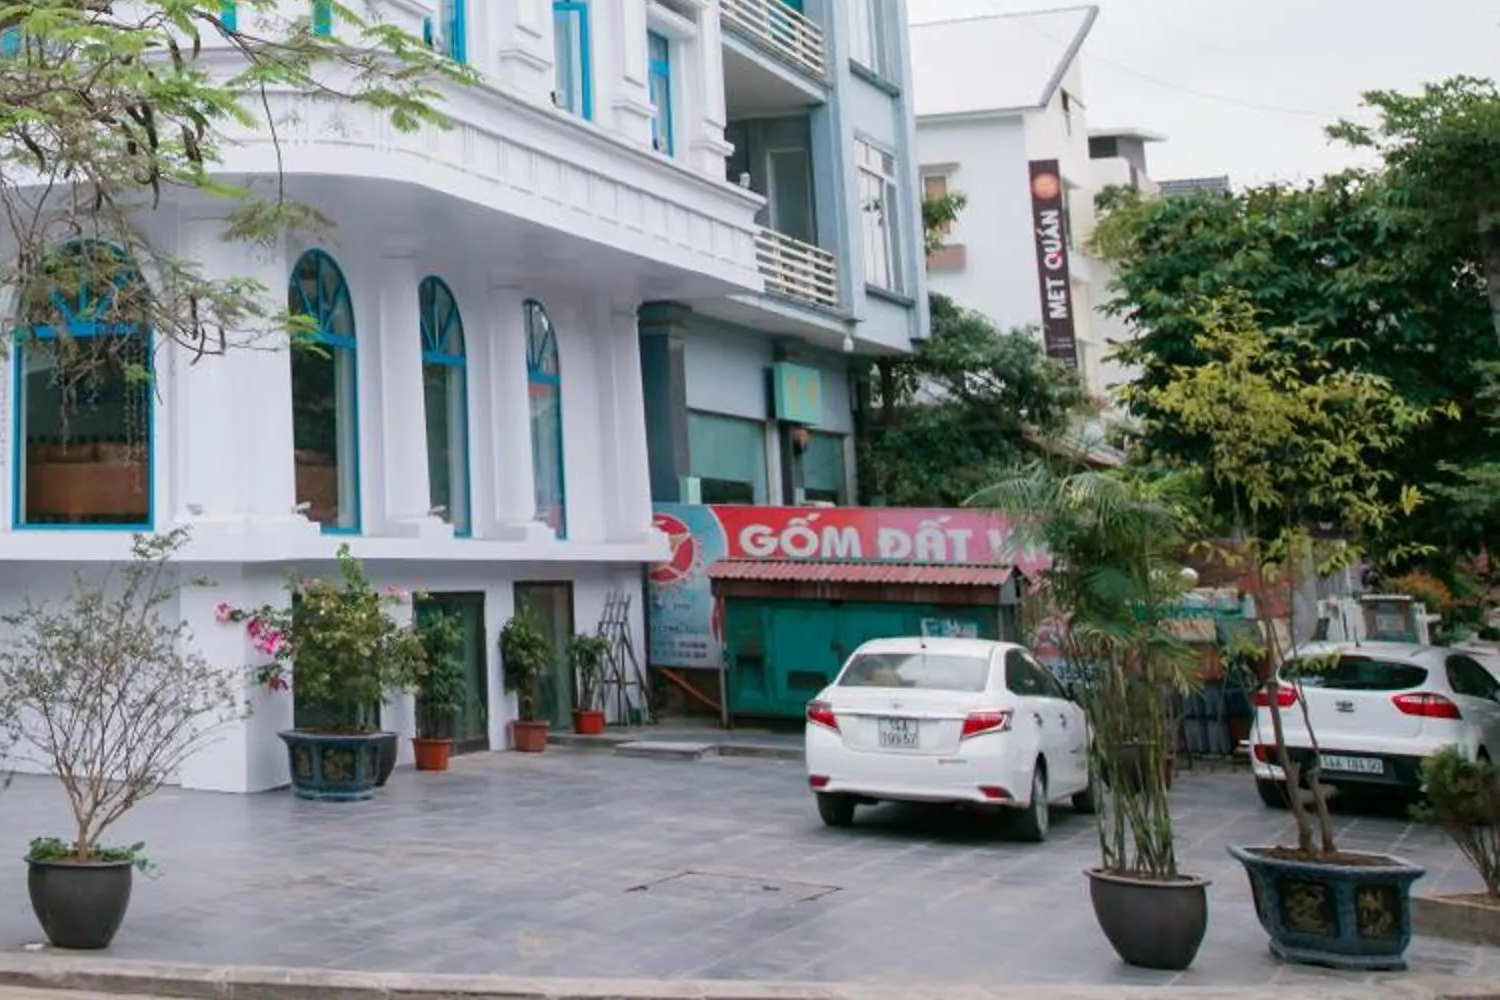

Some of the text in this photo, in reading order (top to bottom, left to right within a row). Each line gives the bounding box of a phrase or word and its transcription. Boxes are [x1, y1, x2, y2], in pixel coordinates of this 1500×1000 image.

[1036, 209, 1063, 271] QUÁN
[1045, 278, 1068, 319] MET
[738, 512, 862, 559] GỐM
[877, 514, 973, 562] ĐẤT
